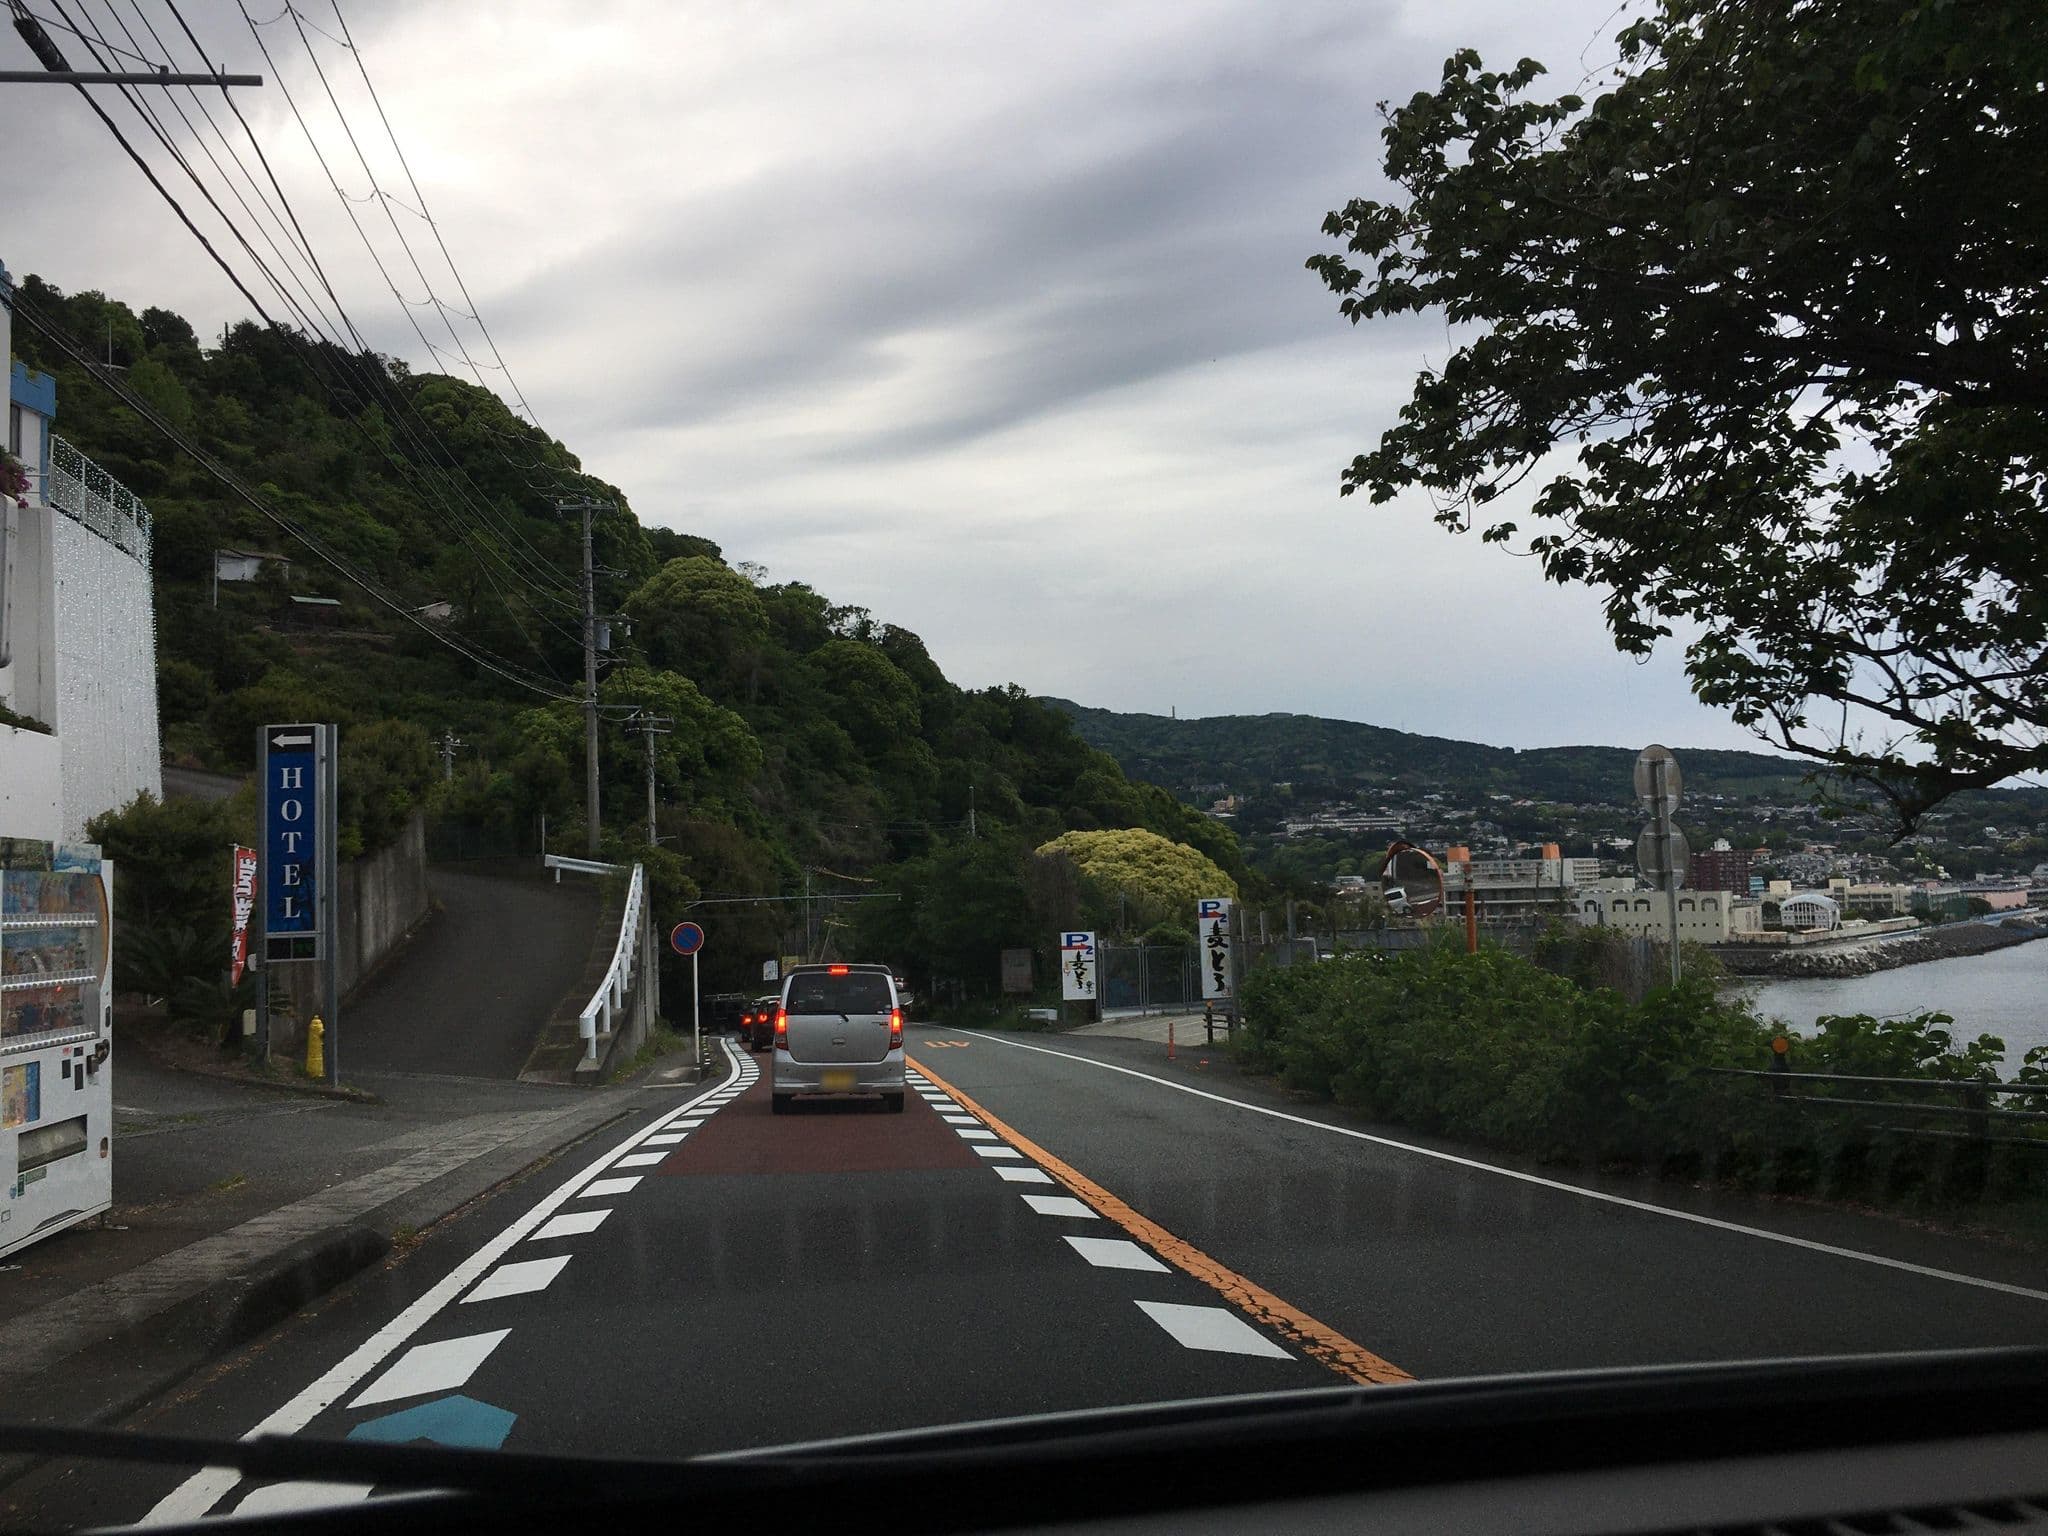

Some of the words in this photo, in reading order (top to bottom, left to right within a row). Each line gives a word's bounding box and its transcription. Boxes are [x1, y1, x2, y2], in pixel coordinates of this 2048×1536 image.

[280, 767, 303, 919] HOTEL
[1204, 920, 1230, 992] 麦とろ
